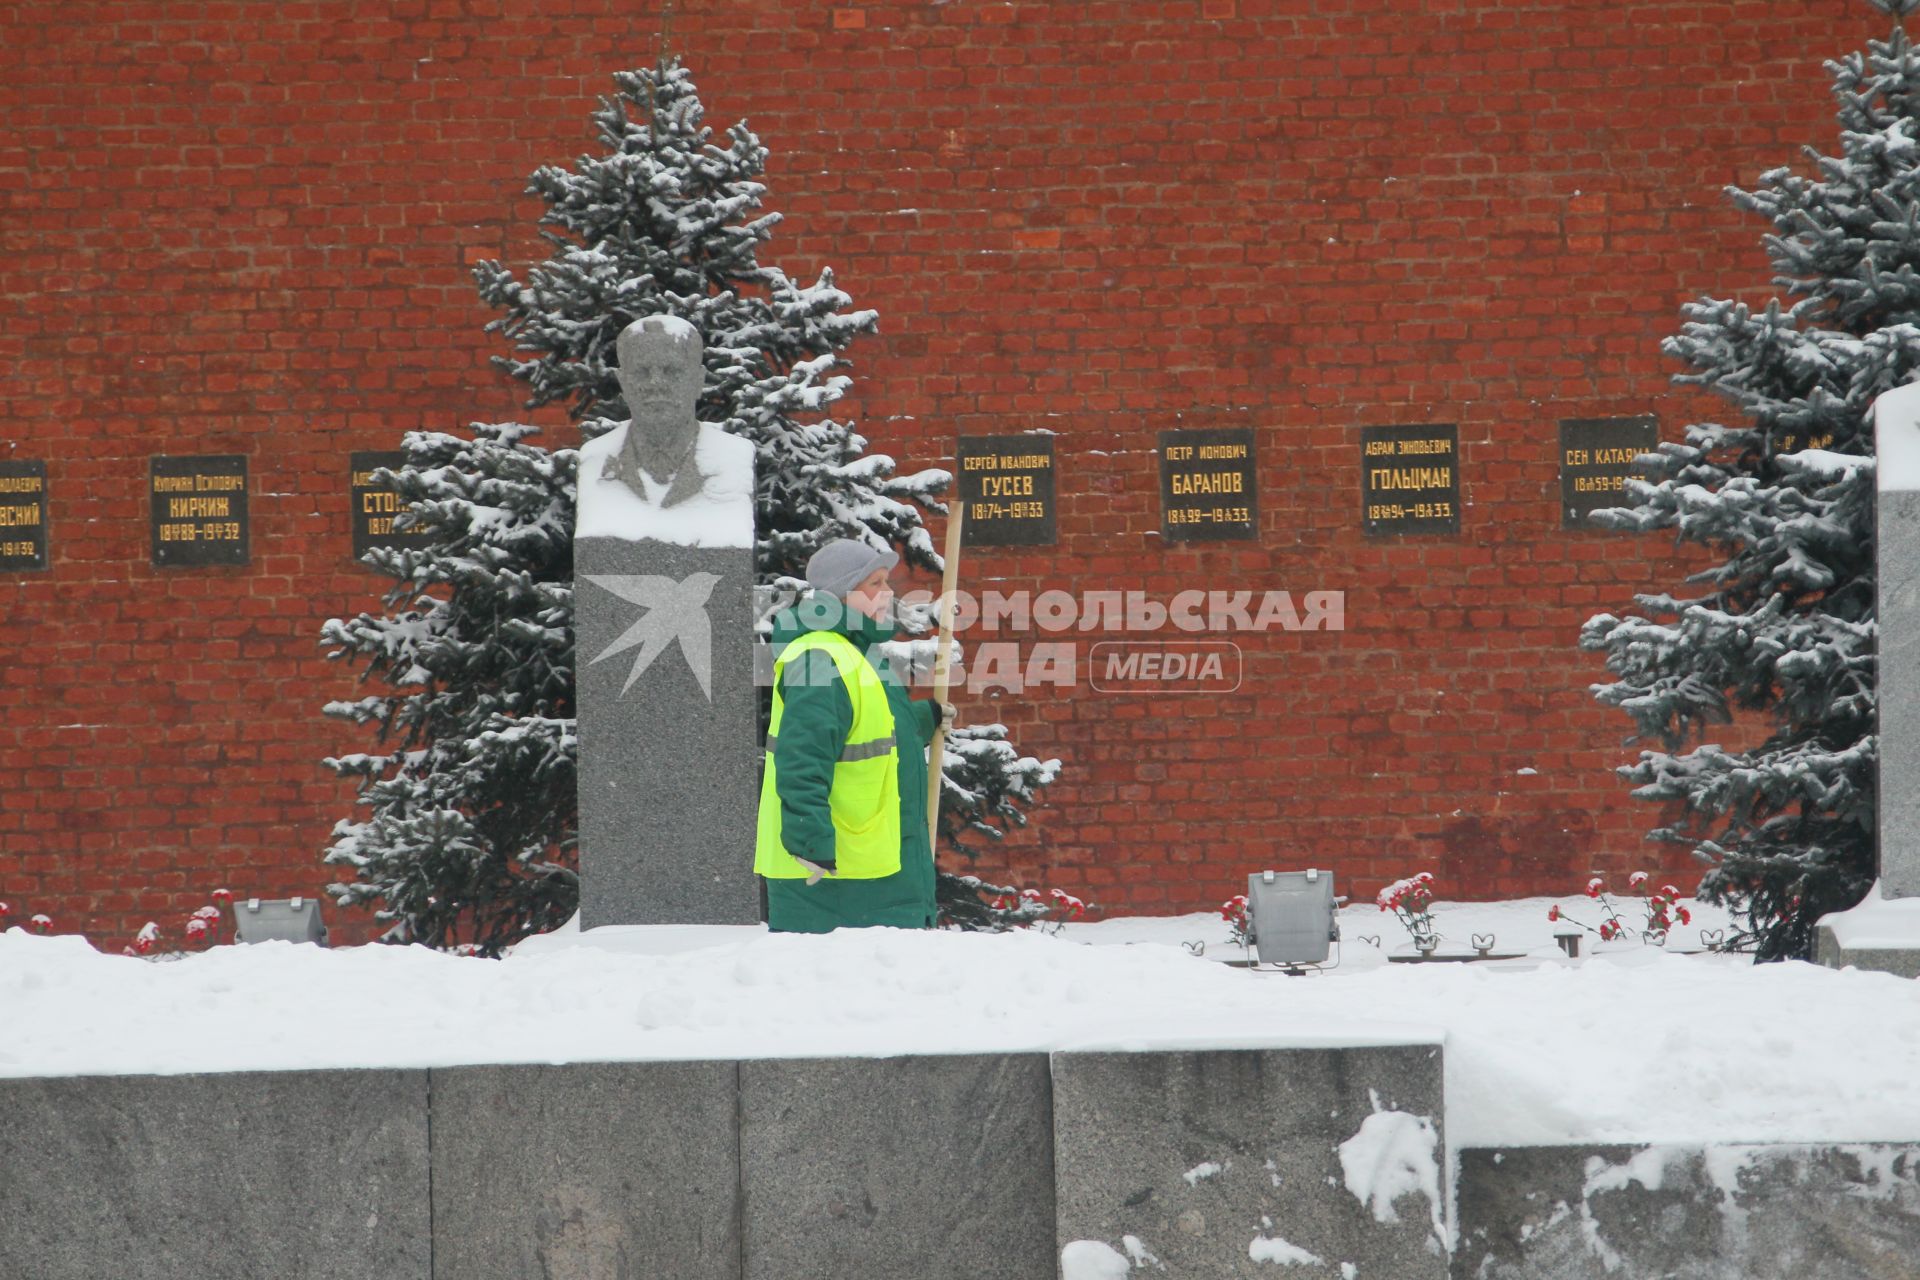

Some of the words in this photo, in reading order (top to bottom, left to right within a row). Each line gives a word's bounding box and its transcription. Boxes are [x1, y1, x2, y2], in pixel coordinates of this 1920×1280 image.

[1166, 446, 1193, 460] ПЕТР
[1200, 444, 1247, 460] ИОНОВИЧ
[1365, 441, 1395, 456] АБРАМ
[1397, 439, 1451, 455] ЗИНОВЬЕВИЧ
[964, 453, 997, 470] СЕРГЕЙ
[1000, 455, 1050, 469] ИВАНОВИЧ
[1566, 449, 1589, 466] СЕН
[982, 475, 1033, 496] ГУСЕВ
[1172, 472, 1243, 495] БАРАНОВ
[1370, 466, 1451, 492] ГОЛЬЦМАН
[170, 497, 229, 518] КИРКИЖ
